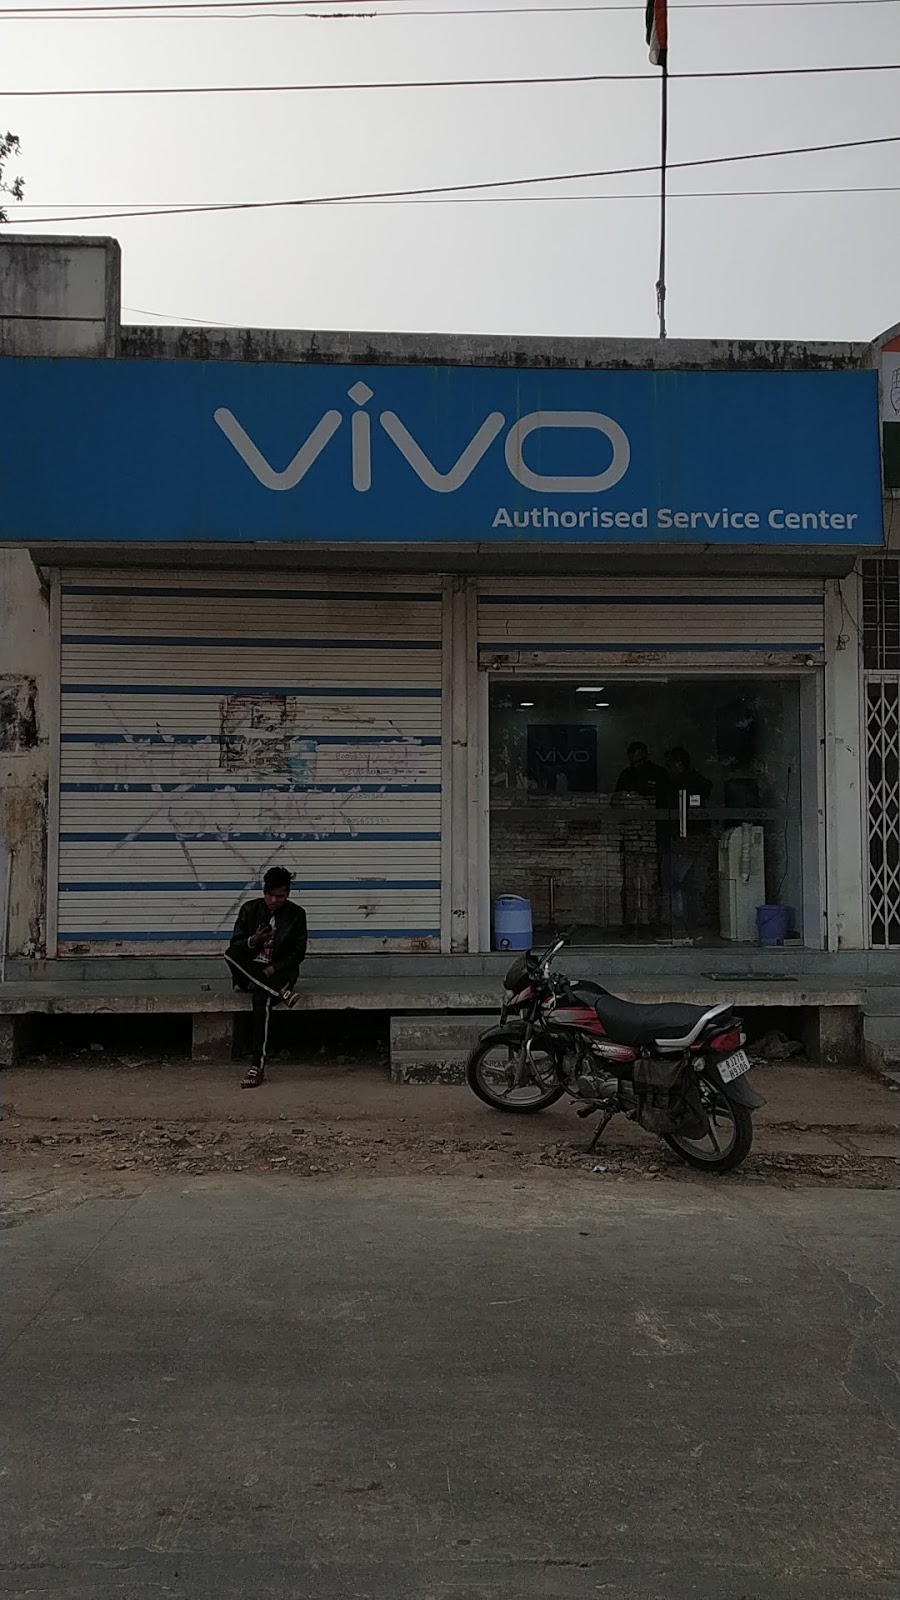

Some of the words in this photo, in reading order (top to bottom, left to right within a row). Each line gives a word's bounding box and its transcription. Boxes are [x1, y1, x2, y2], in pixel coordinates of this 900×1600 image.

[214, 381, 631, 492] vivo
[492, 507, 648, 529] Authorised
[657, 507, 761, 530] Service
[768, 508, 858, 530] Center
[535, 746, 591, 763] vivo
[725, 1052, 745, 1070] RJ27B
